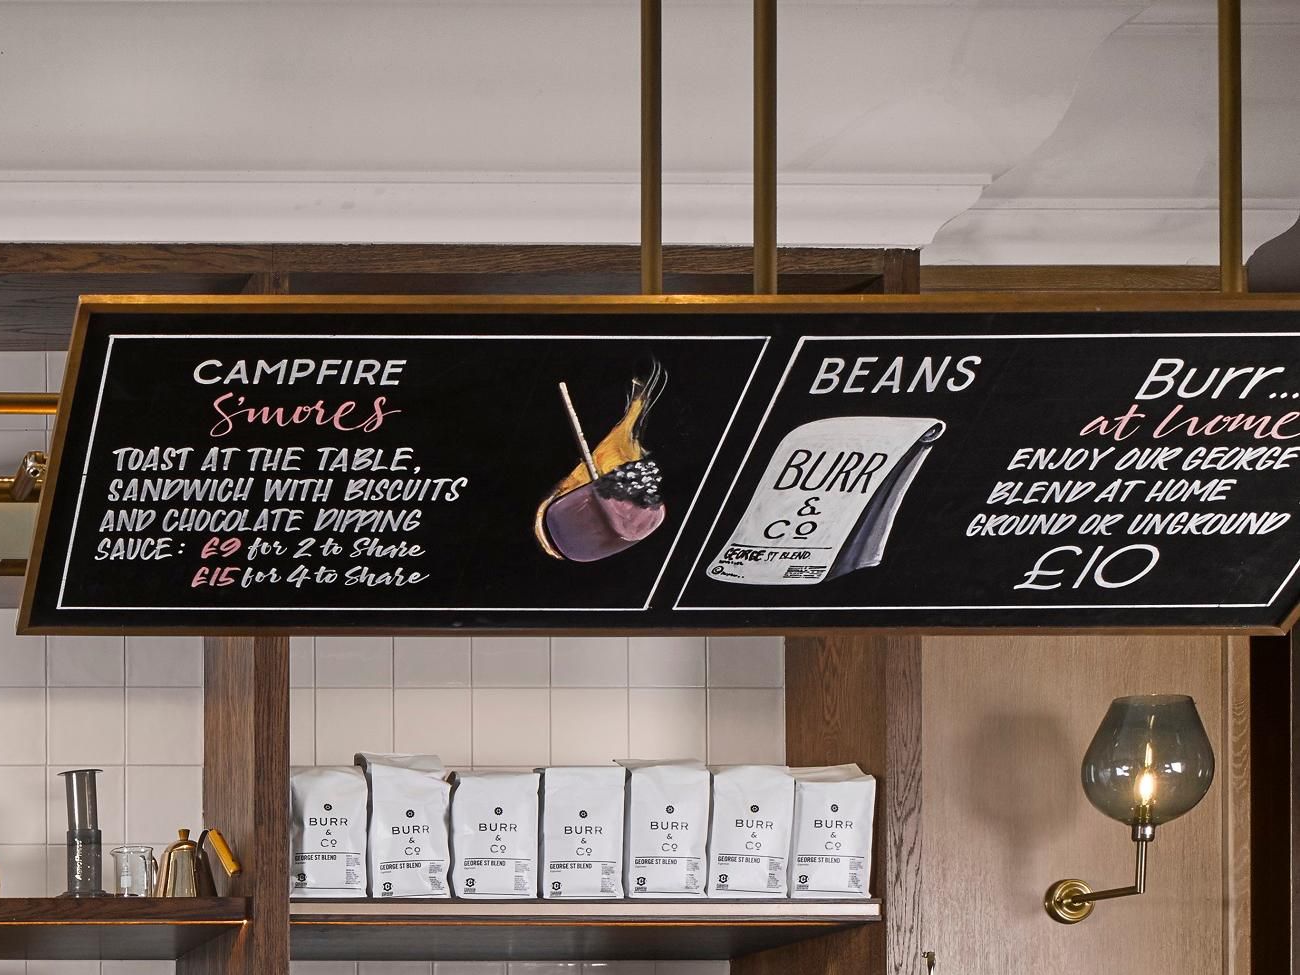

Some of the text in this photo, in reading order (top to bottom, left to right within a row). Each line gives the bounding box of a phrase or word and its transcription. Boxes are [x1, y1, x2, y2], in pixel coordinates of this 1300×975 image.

[194, 359, 407, 385] CAMPFIRE
[809, 356, 981, 394] BEANS
[1080, 404, 1300, 441] at home
[113, 446, 420, 474] TOAST AT THE TABLE,
[1007, 446, 1300, 470] ENJOY OUR GEORGE
[773, 449, 888, 493] BURR
[108, 477, 468, 502] SANDWICH WITH BISCUITS
[987, 479, 1237, 505] BLEND AT HOME
[797, 497, 821, 516] &
[99, 508, 421, 532] AND CHOCOLATE DIPPING
[966, 512, 1291, 536] GROUND OR UNGROUND
[201, 537, 241, 558] £9
[248, 537, 287, 560] for
[293, 538, 316, 558] 2
[320, 538, 342, 556] to
[724, 547, 764, 561] GEORGE
[765, 551, 778, 561] ST
[191, 567, 237, 587] £15
[241, 567, 281, 588] for
[287, 565, 311, 588] 4
[314, 566, 337, 583] to
[1014, 544, 1159, 590] £10
[309, 817, 348, 826] BURR
[392, 825, 430, 835] BURR
[479, 823, 518, 832] BURR
[564, 825, 603, 835] BURR
[650, 821, 688, 831] BURR
[735, 819, 774, 830] BURR
[814, 819, 853, 829] BURR
